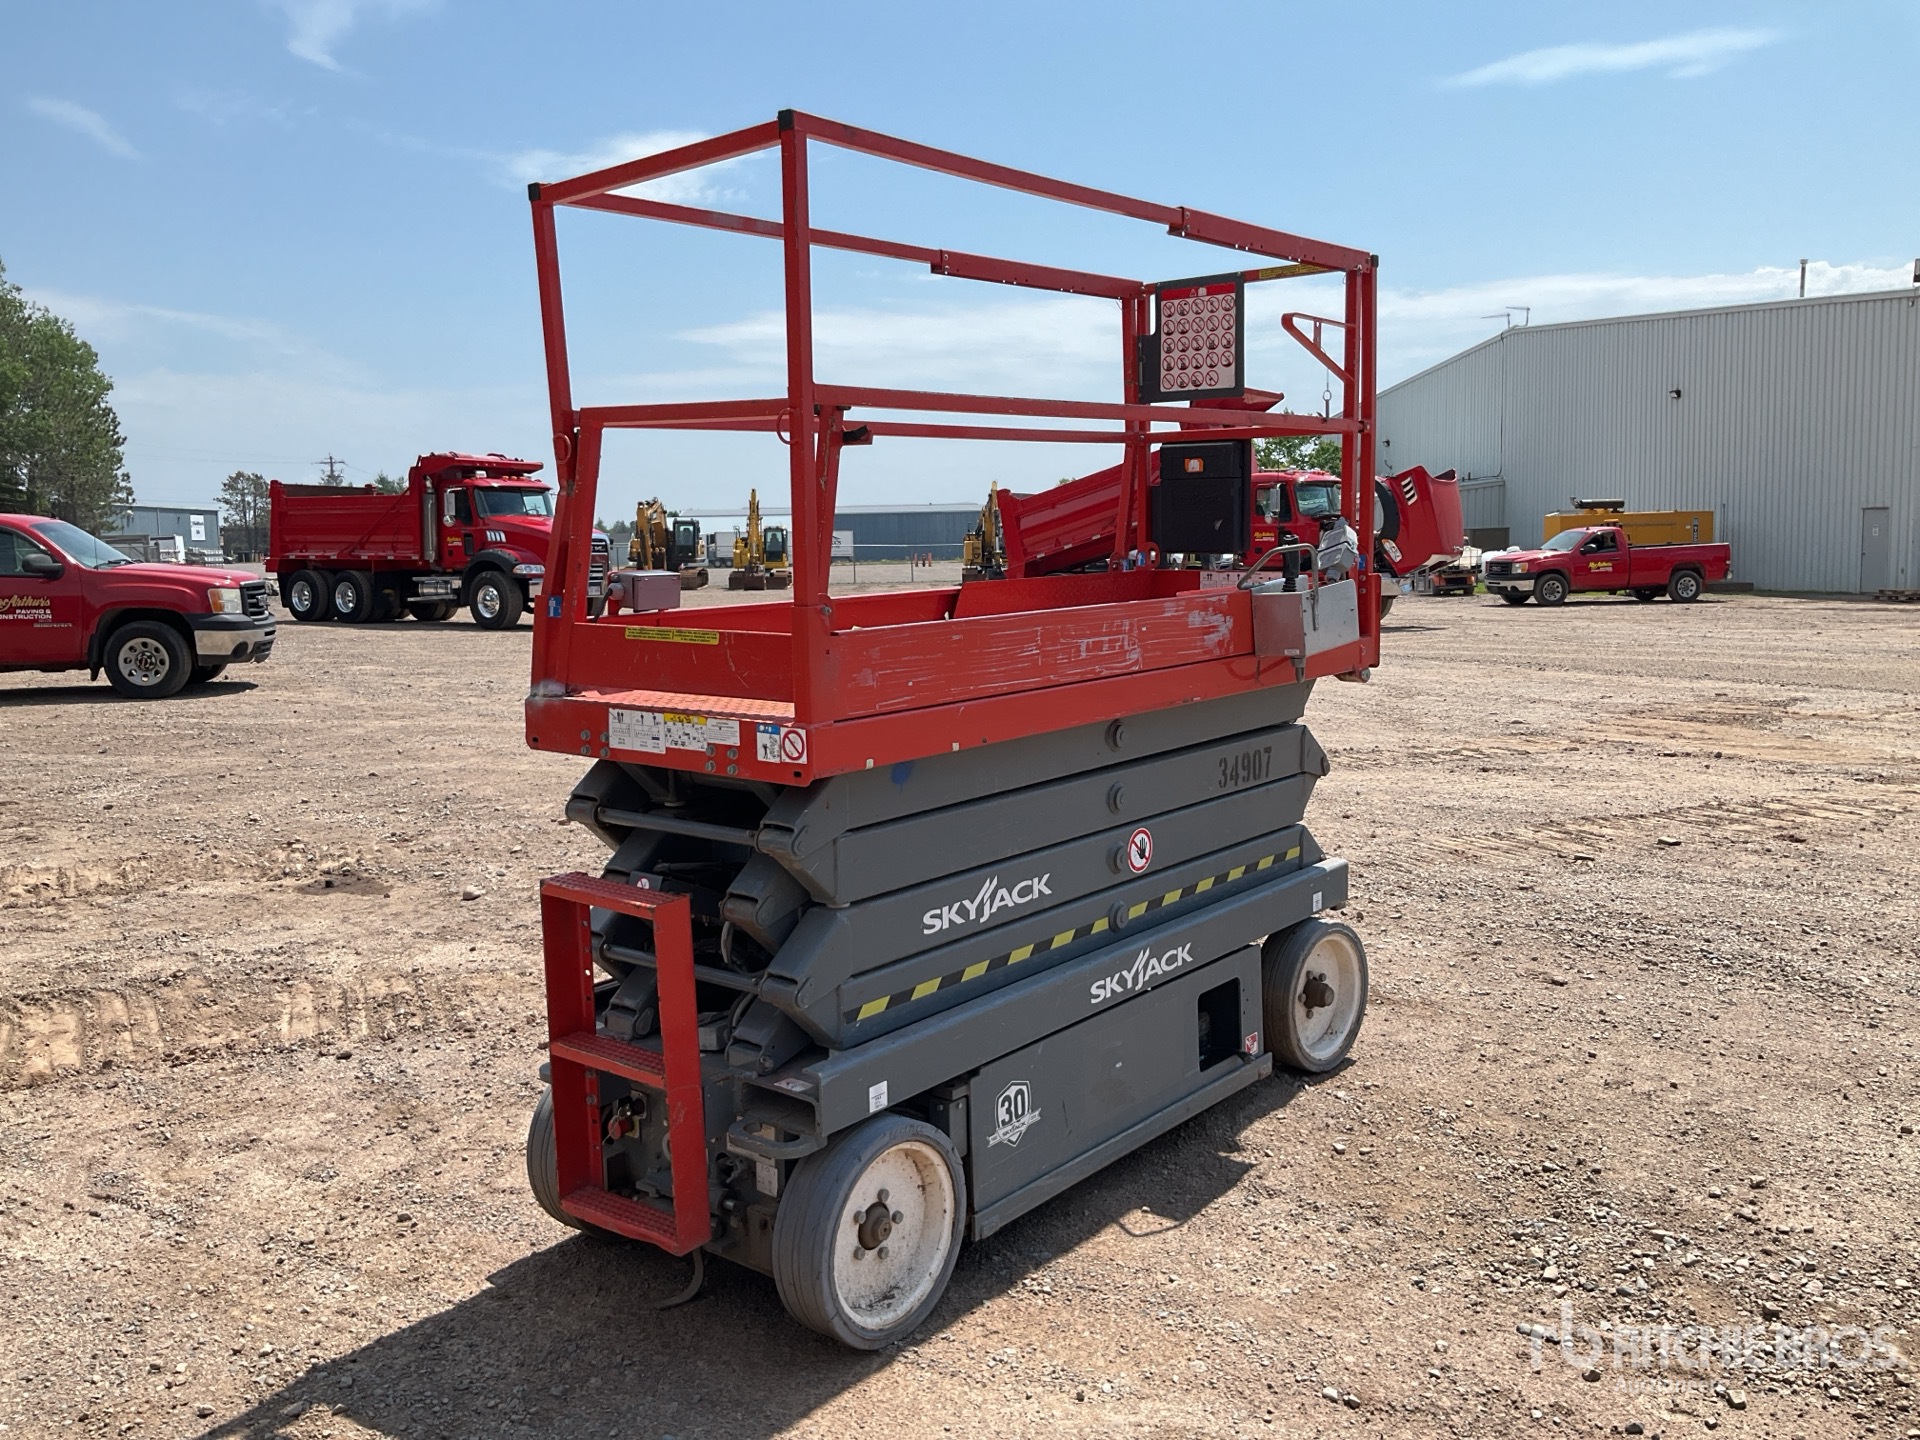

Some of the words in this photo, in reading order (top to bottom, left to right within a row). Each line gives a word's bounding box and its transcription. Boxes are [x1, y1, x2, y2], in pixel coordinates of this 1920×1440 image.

[1218, 746, 1272, 789] 34907
[922, 873, 1053, 935] SKYJACK
[1090, 942, 1194, 1004] SKYJACK
[1000, 1088, 1026, 1128] 30
